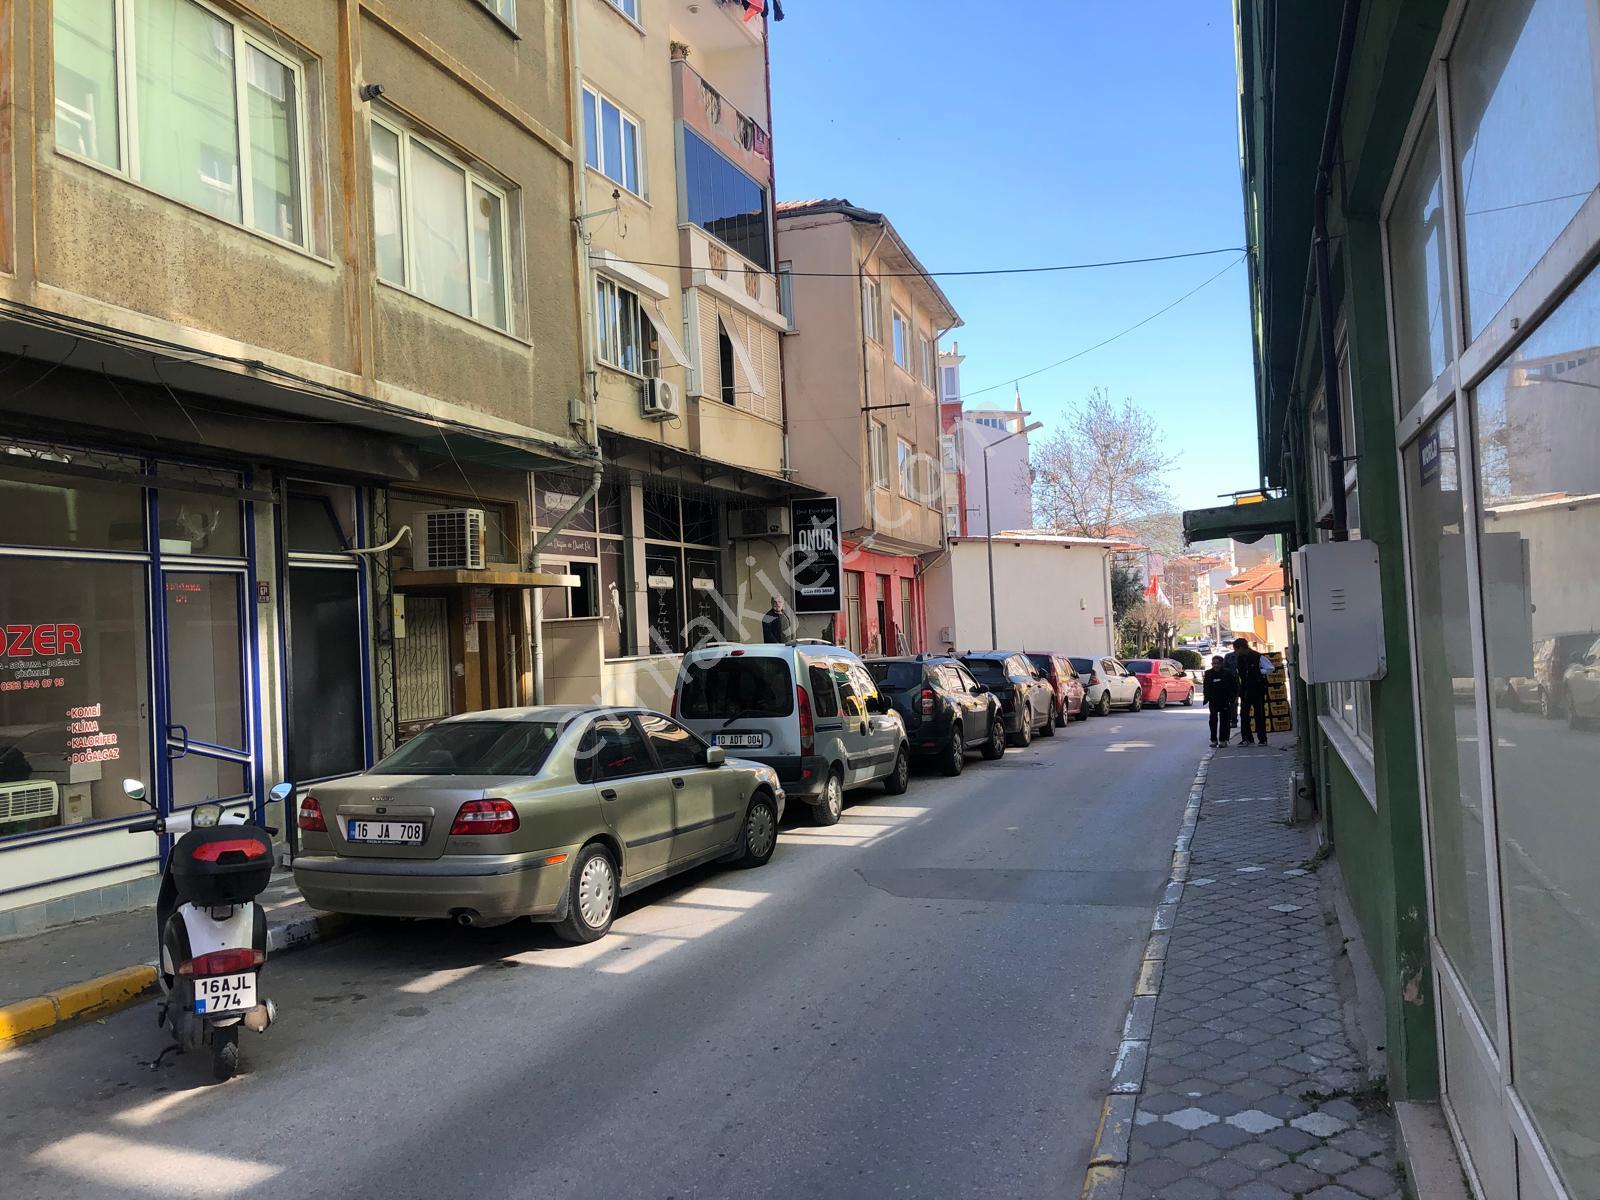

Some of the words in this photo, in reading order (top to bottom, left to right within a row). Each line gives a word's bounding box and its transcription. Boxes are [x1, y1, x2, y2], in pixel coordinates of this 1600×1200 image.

[798, 528, 834, 552] ONUR
[0, 623, 82, 657] ZER
[717, 735, 726, 745] 10
[729, 735, 743, 745] ADT
[747, 735, 761, 744] 004
[357, 823, 368, 838] 16
[377, 823, 390, 839] JA
[400, 824, 421, 840] 708
[201, 976, 251, 995] 16AJL
[211, 993, 241, 1009] 774
